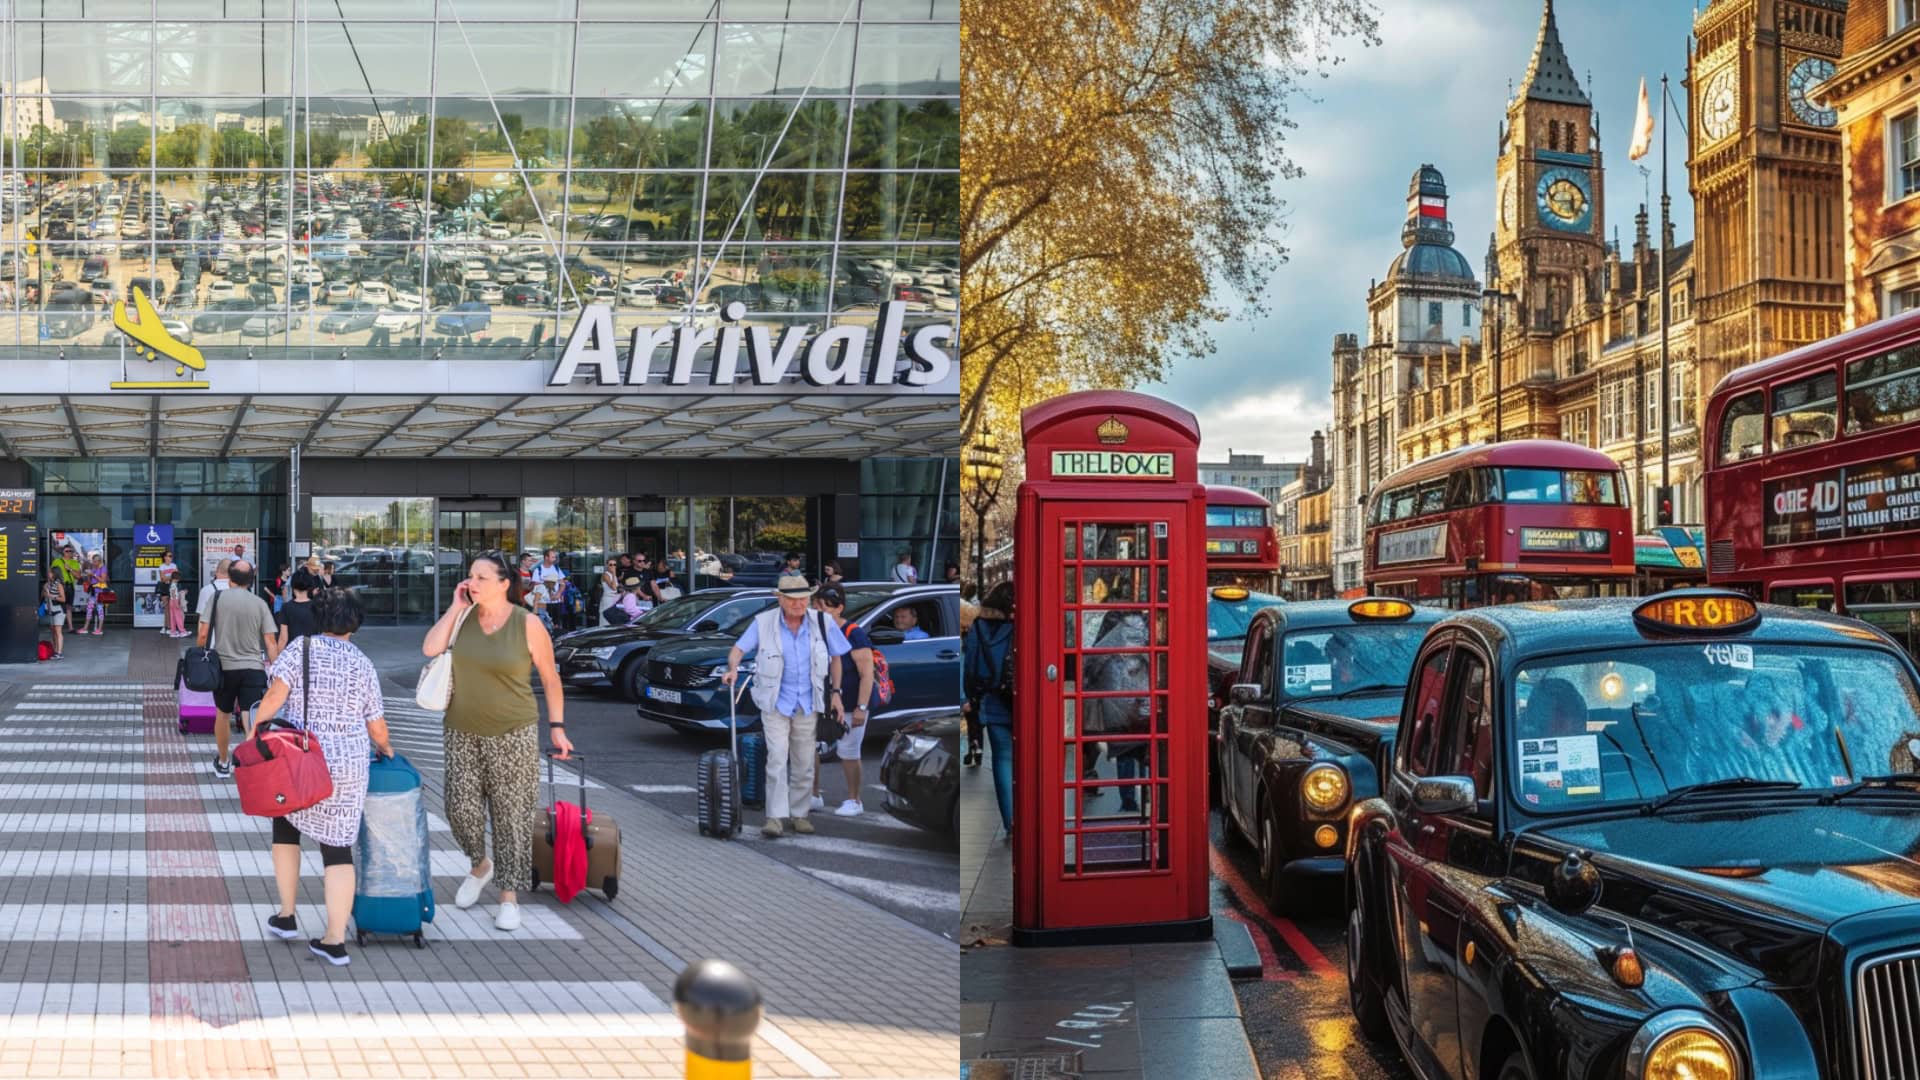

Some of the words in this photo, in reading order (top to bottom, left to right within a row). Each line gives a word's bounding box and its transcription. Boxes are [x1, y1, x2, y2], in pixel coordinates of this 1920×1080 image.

[547, 300, 953, 388] Arrivals
[206, 536, 223, 544] free
[225, 535, 252, 545] public
[206, 545, 247, 554] transpt
